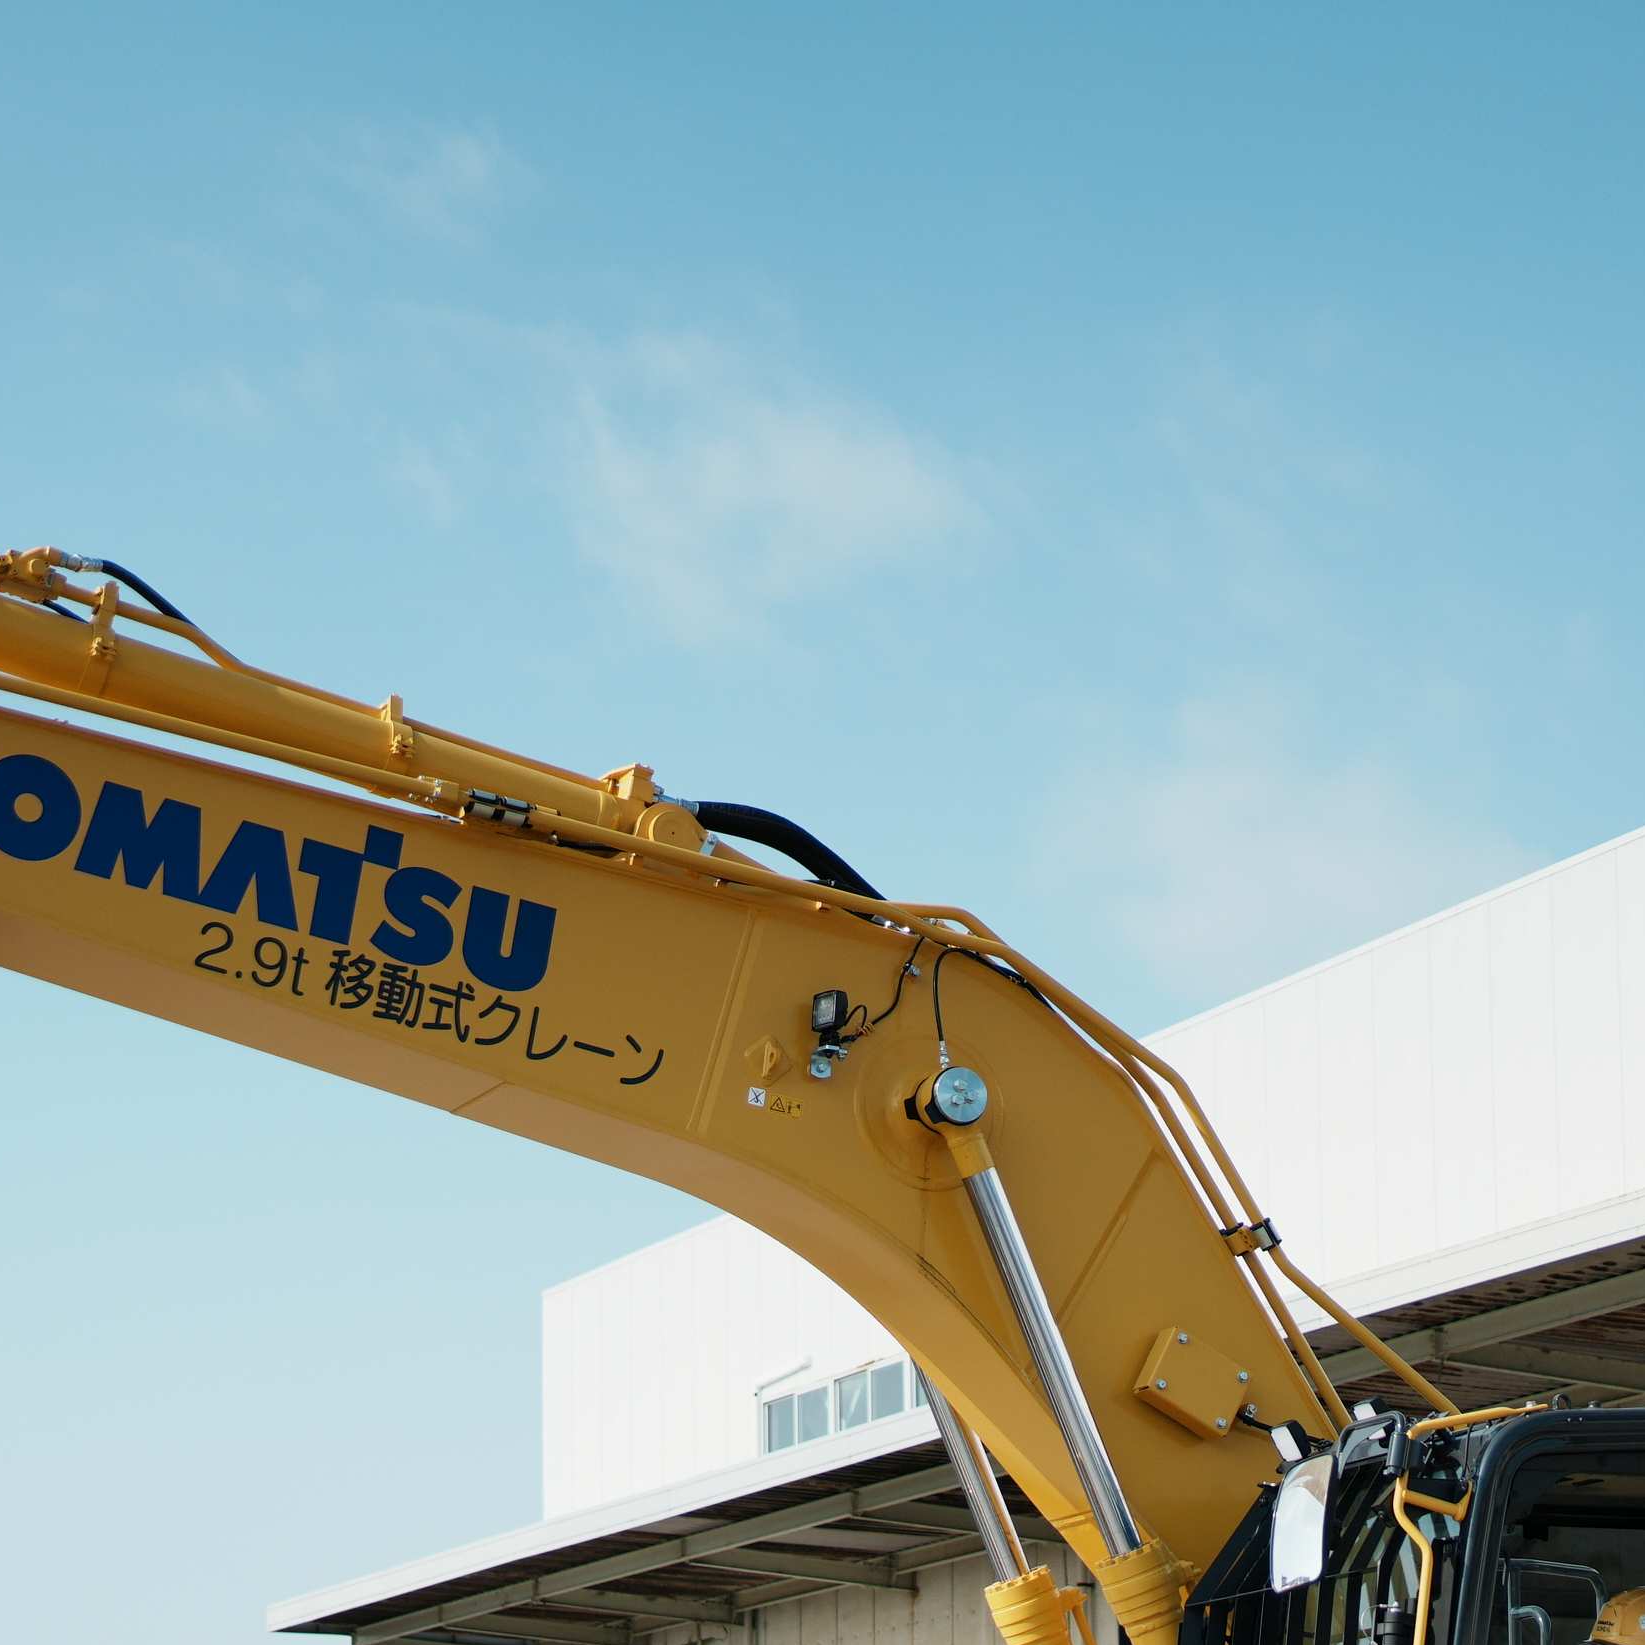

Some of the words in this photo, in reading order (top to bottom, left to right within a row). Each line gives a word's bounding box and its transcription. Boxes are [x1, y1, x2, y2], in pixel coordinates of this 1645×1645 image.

[194, 921, 311, 997] 2.9t
[324, 949, 665, 1086] 移動式クレーン
